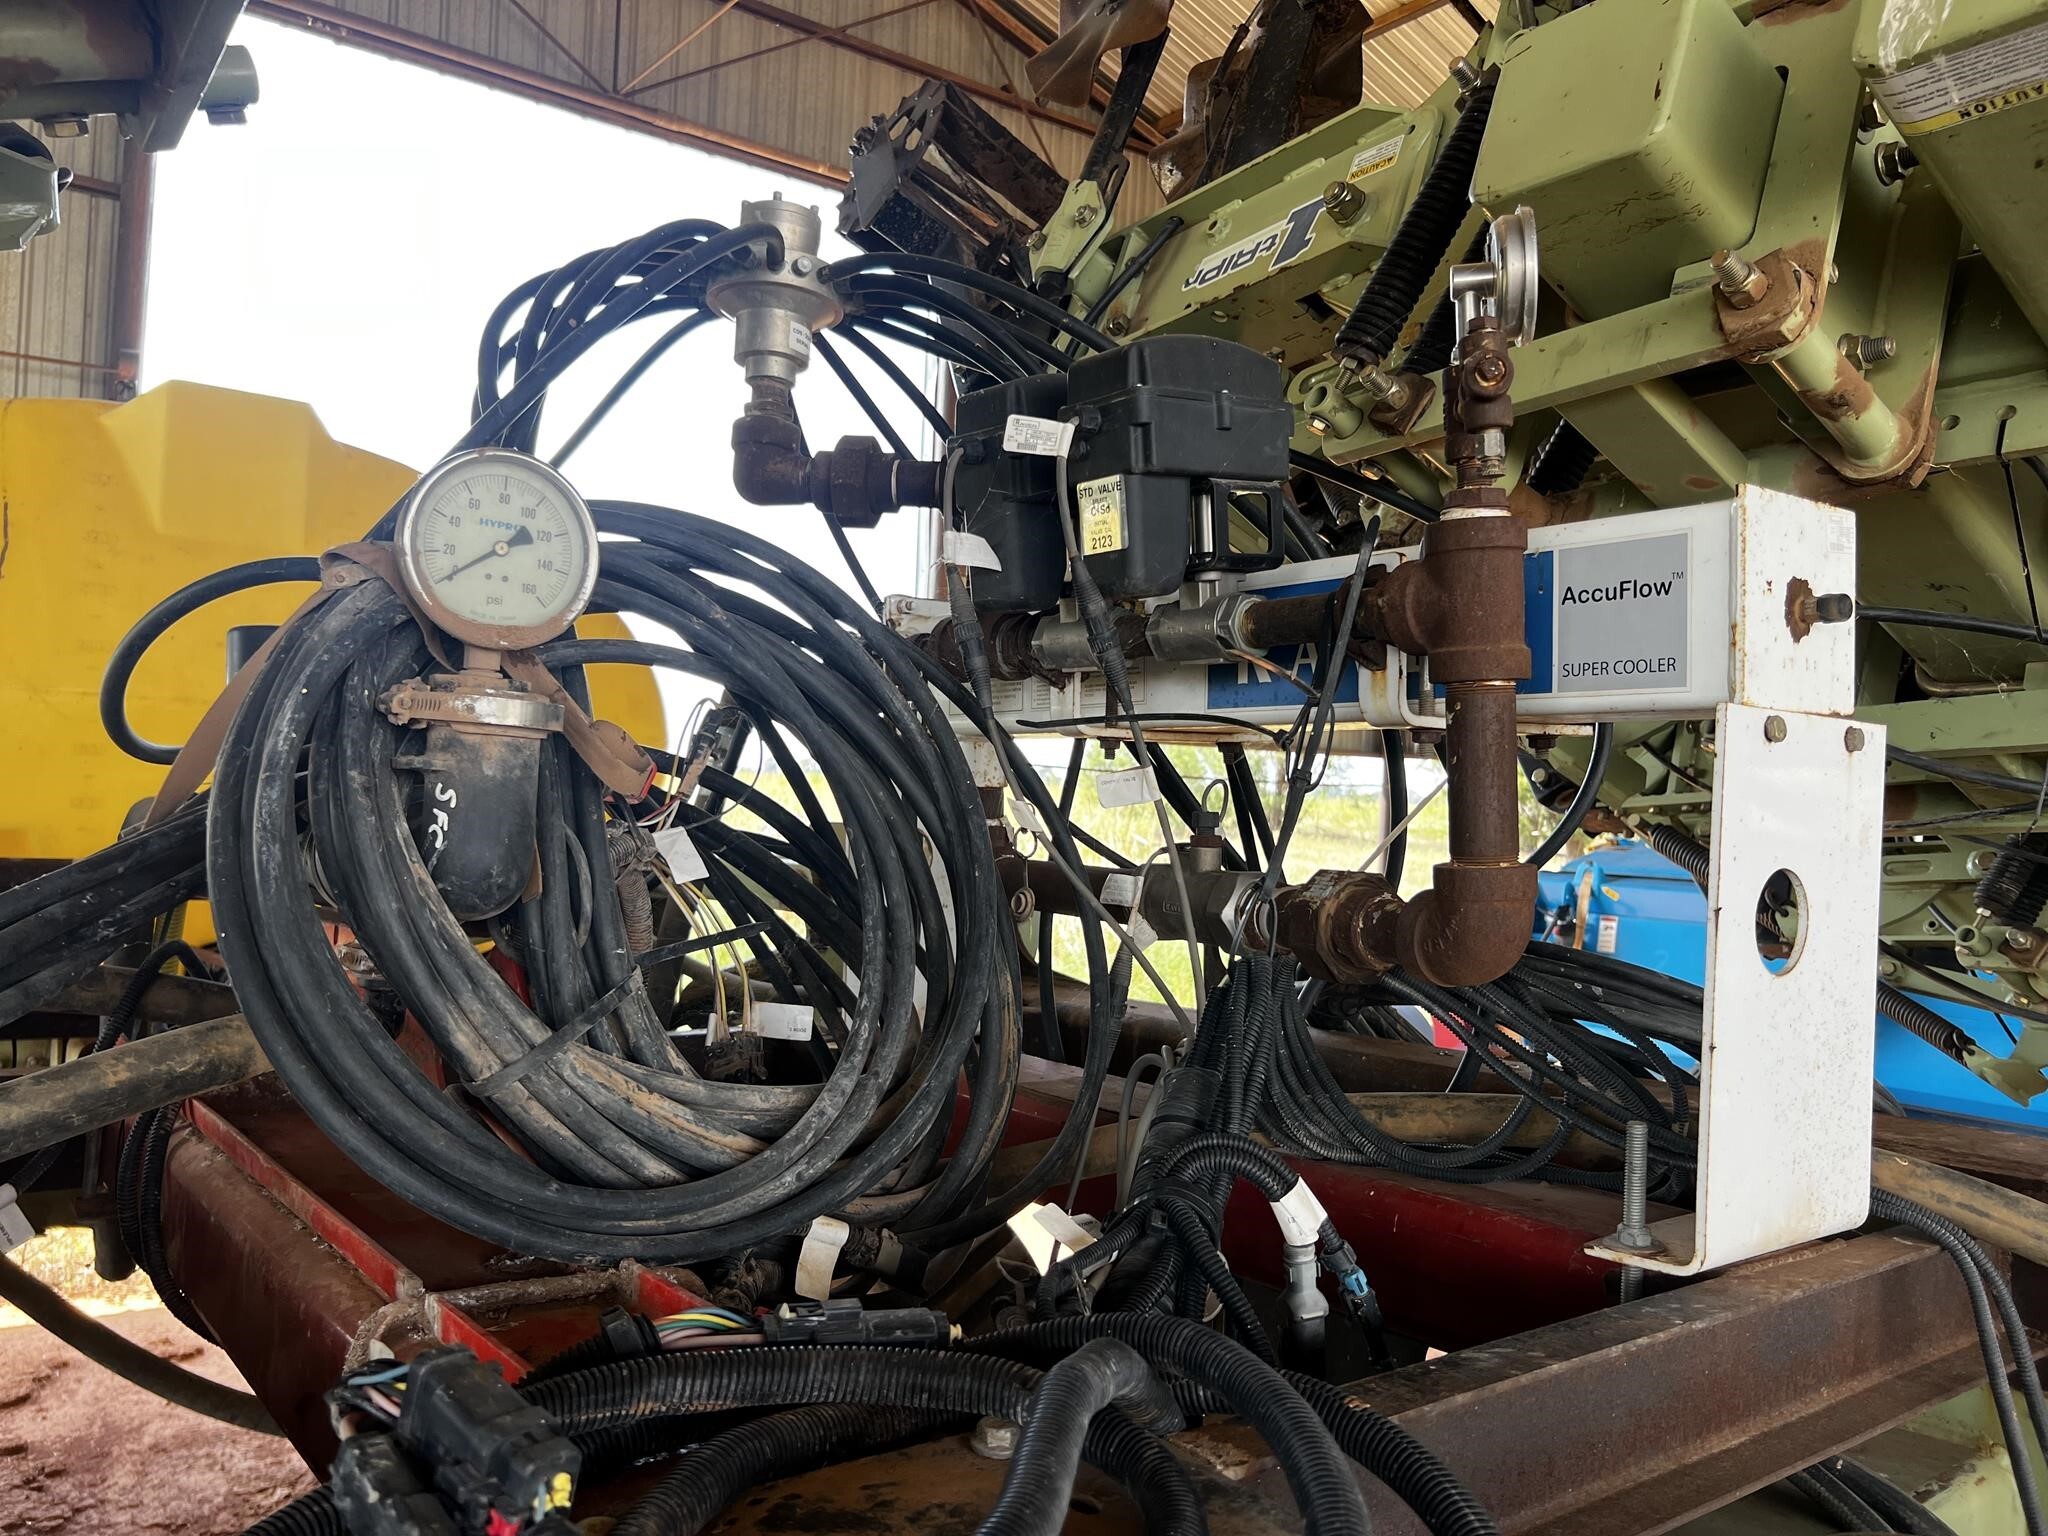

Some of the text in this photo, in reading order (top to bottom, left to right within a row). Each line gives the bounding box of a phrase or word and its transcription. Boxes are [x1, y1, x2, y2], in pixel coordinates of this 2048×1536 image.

[1957, 84, 2045, 119] AUTION
[1350, 159, 1387, 180] CAUTION
[1079, 480, 1122, 499] STD VALVE
[468, 498, 480, 510] 60
[498, 492, 511, 505] 80
[521, 507, 536, 519] 100
[448, 516, 461, 528] 40
[536, 530, 552, 543] 120
[1092, 535, 1112, 550] 2123
[443, 544, 455, 556] 20
[537, 560, 553, 572] 140
[522, 583, 537, 595] 160
[1561, 579, 1673, 606] AccuFlow
[486, 595, 503, 607] psi
[1562, 657, 1676, 678] SUPER COOLER
